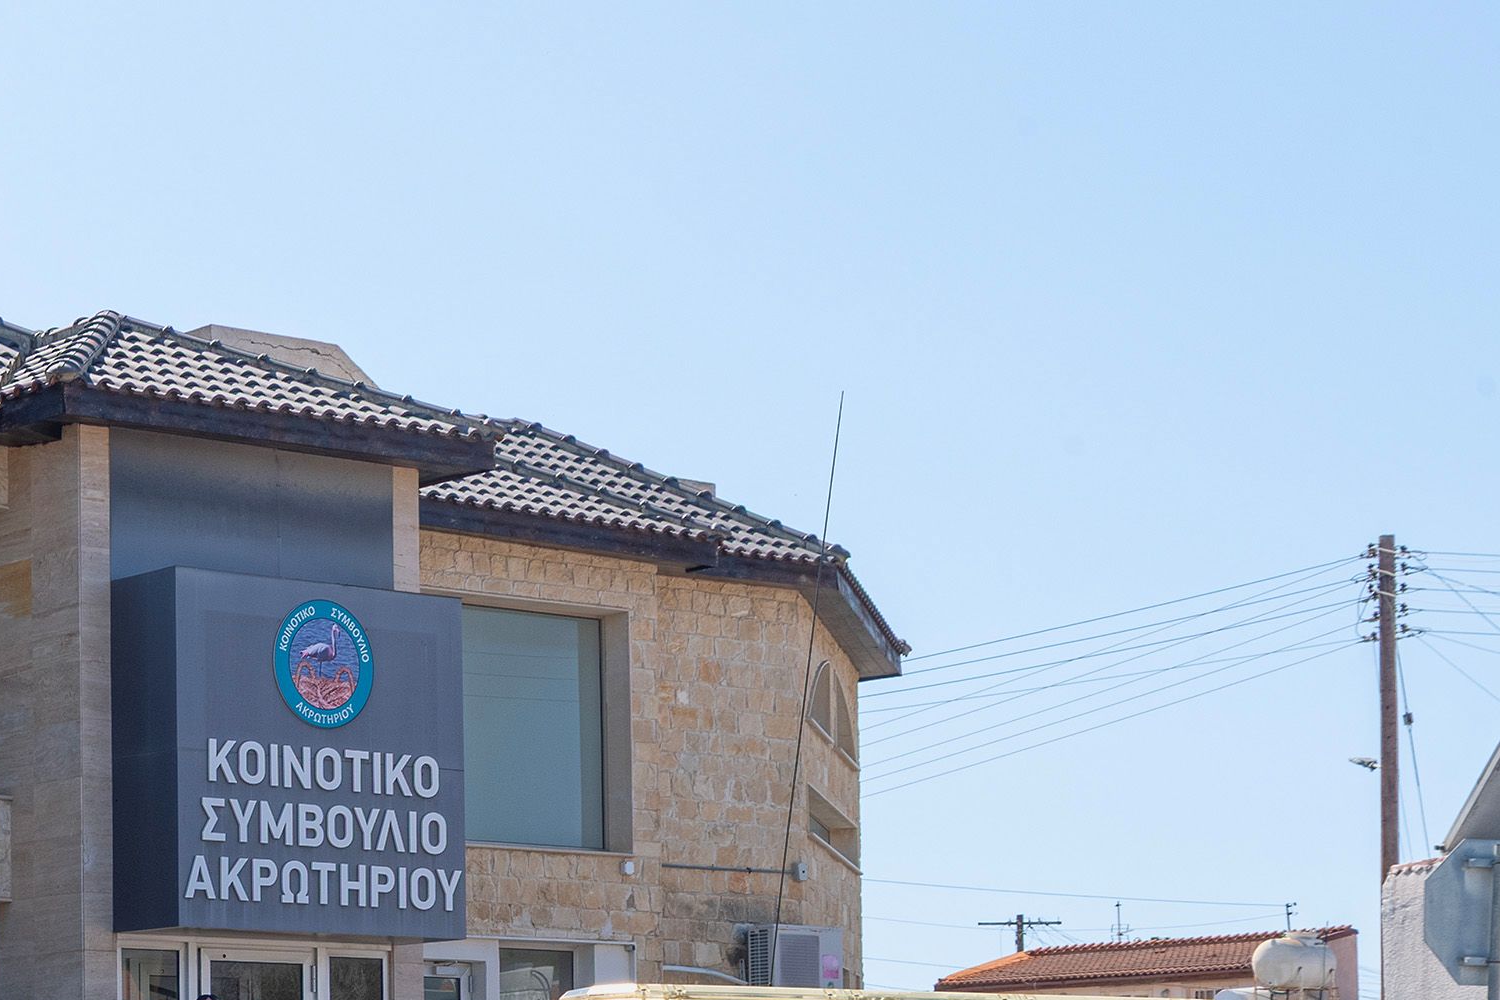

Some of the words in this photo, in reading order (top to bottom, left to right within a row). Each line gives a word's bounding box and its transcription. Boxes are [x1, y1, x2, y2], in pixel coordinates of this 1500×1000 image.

[279, 606, 316, 651] ΚΟΙΝΟΤΙΚΟ
[330, 608, 369, 663] ΣΥΜΒΟΥΛΙΟ
[296, 702, 354, 724] ΑΚΡΩΤΗΡΙΟΥ
[208, 738, 440, 799] ΚΟΙΝΟΤΙΚΟ
[201, 796, 448, 855] ΣΥΜΒΟΥΛΙΟ
[185, 855, 462, 912] ΑΚΡΩΤΗΡΙΟΥ
